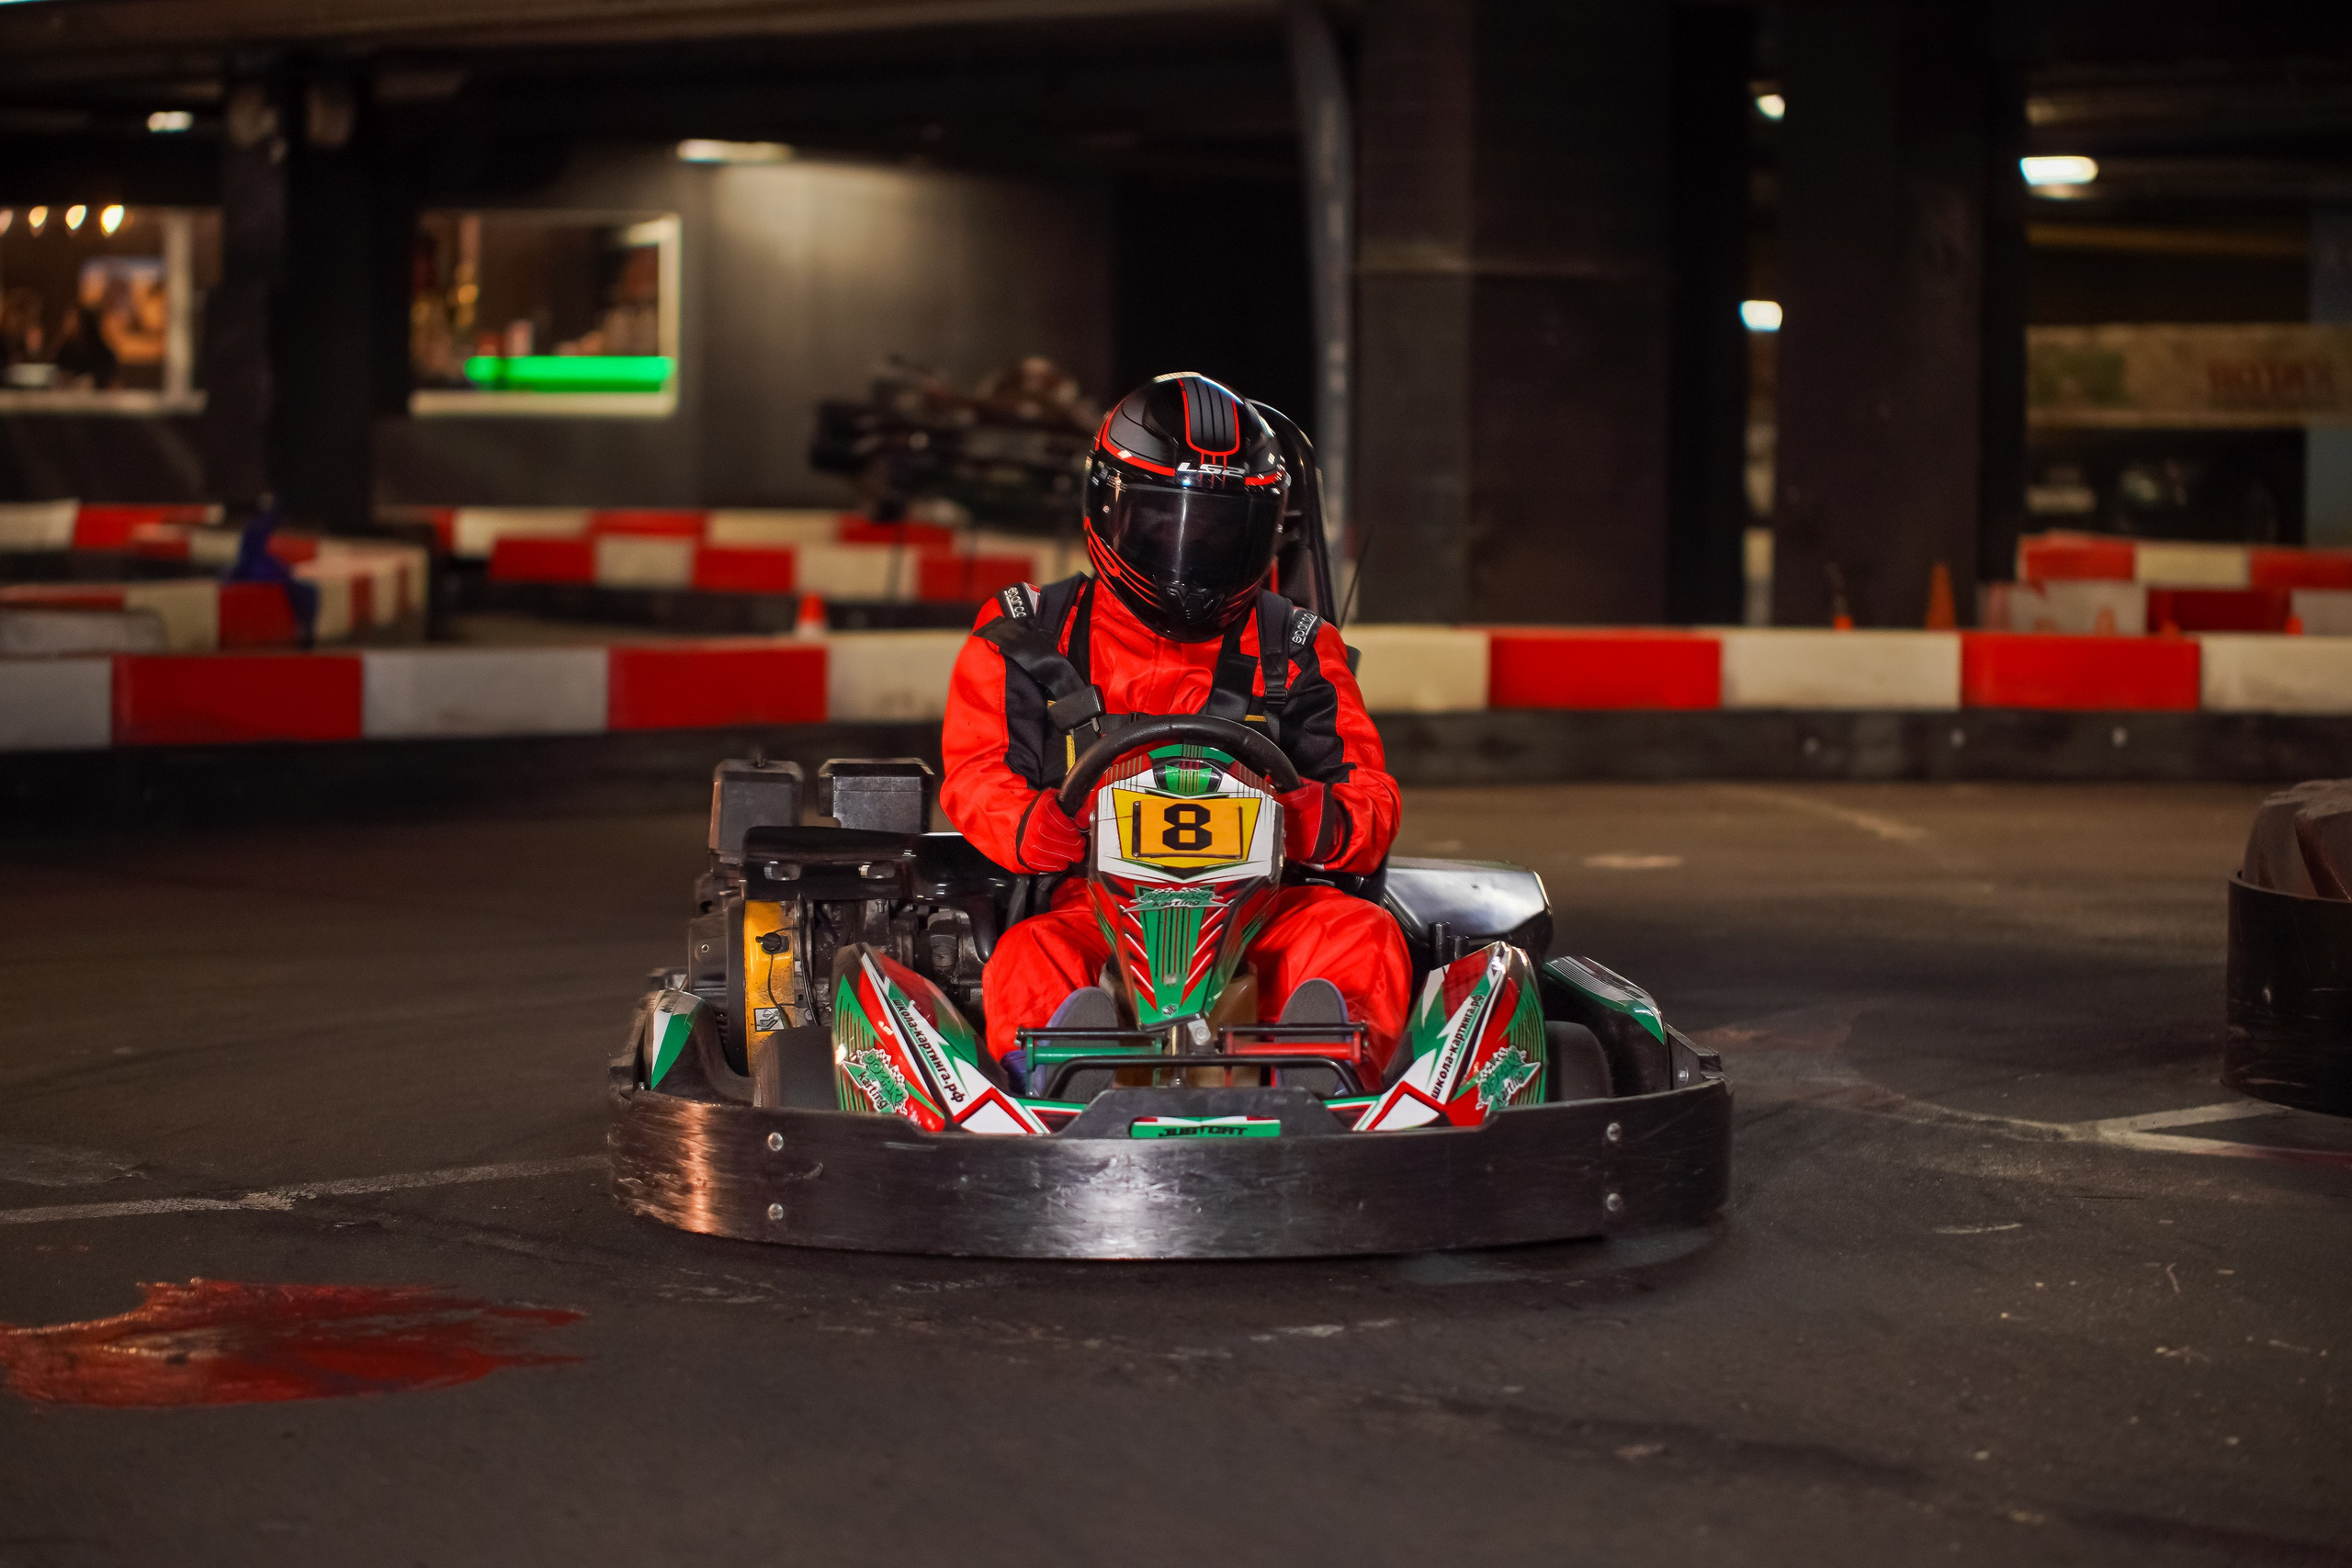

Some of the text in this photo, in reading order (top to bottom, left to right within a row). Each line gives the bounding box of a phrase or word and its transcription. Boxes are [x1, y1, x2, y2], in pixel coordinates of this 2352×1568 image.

[1177, 461, 1246, 479] LS2
[1162, 803, 1213, 851] 8
[893, 998, 964, 1103] школа-картинга.рф
[1431, 994, 1485, 1100] школа-картинга.рф
[858, 1071, 888, 1110] karting
